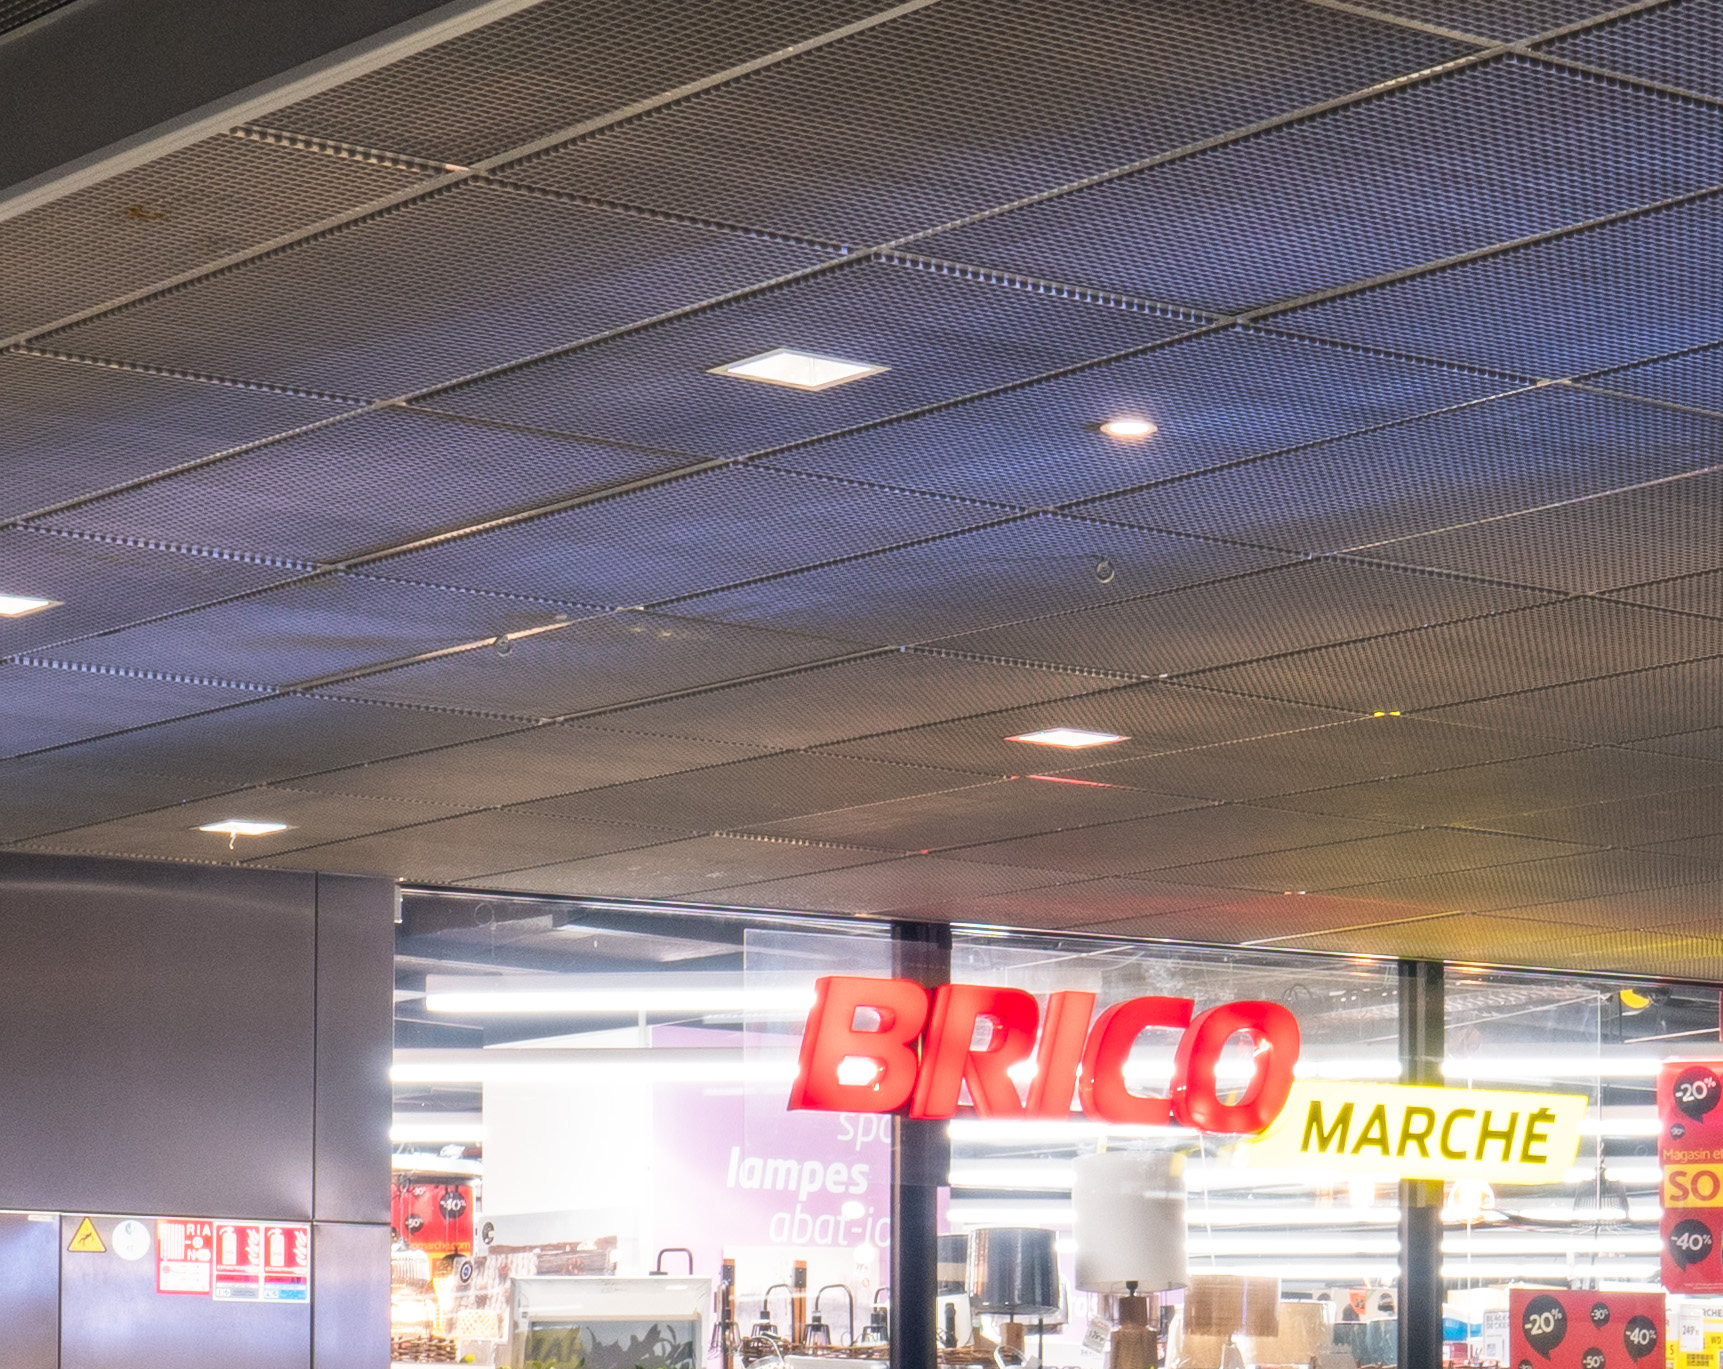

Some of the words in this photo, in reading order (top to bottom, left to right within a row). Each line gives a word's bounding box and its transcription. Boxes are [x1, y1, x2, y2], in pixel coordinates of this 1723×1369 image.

[787, 974, 1302, 1134] BRICO
[1674, 1076, 1717, 1102] -20%
[1300, 1101, 1556, 1165] MARCHÉ
[1663, 1148, 1710, 1163] Magasin
[727, 1147, 870, 1201] lampes
[187, 1223, 211, 1236] RIA
[1670, 1231, 1712, 1251] -40%
[1524, 1308, 1562, 1335] -20%
[1590, 1308, 1608, 1320] -30%
[1625, 1327, 1657, 1345] -40%
[1582, 1355, 1604, 1369] -50%
